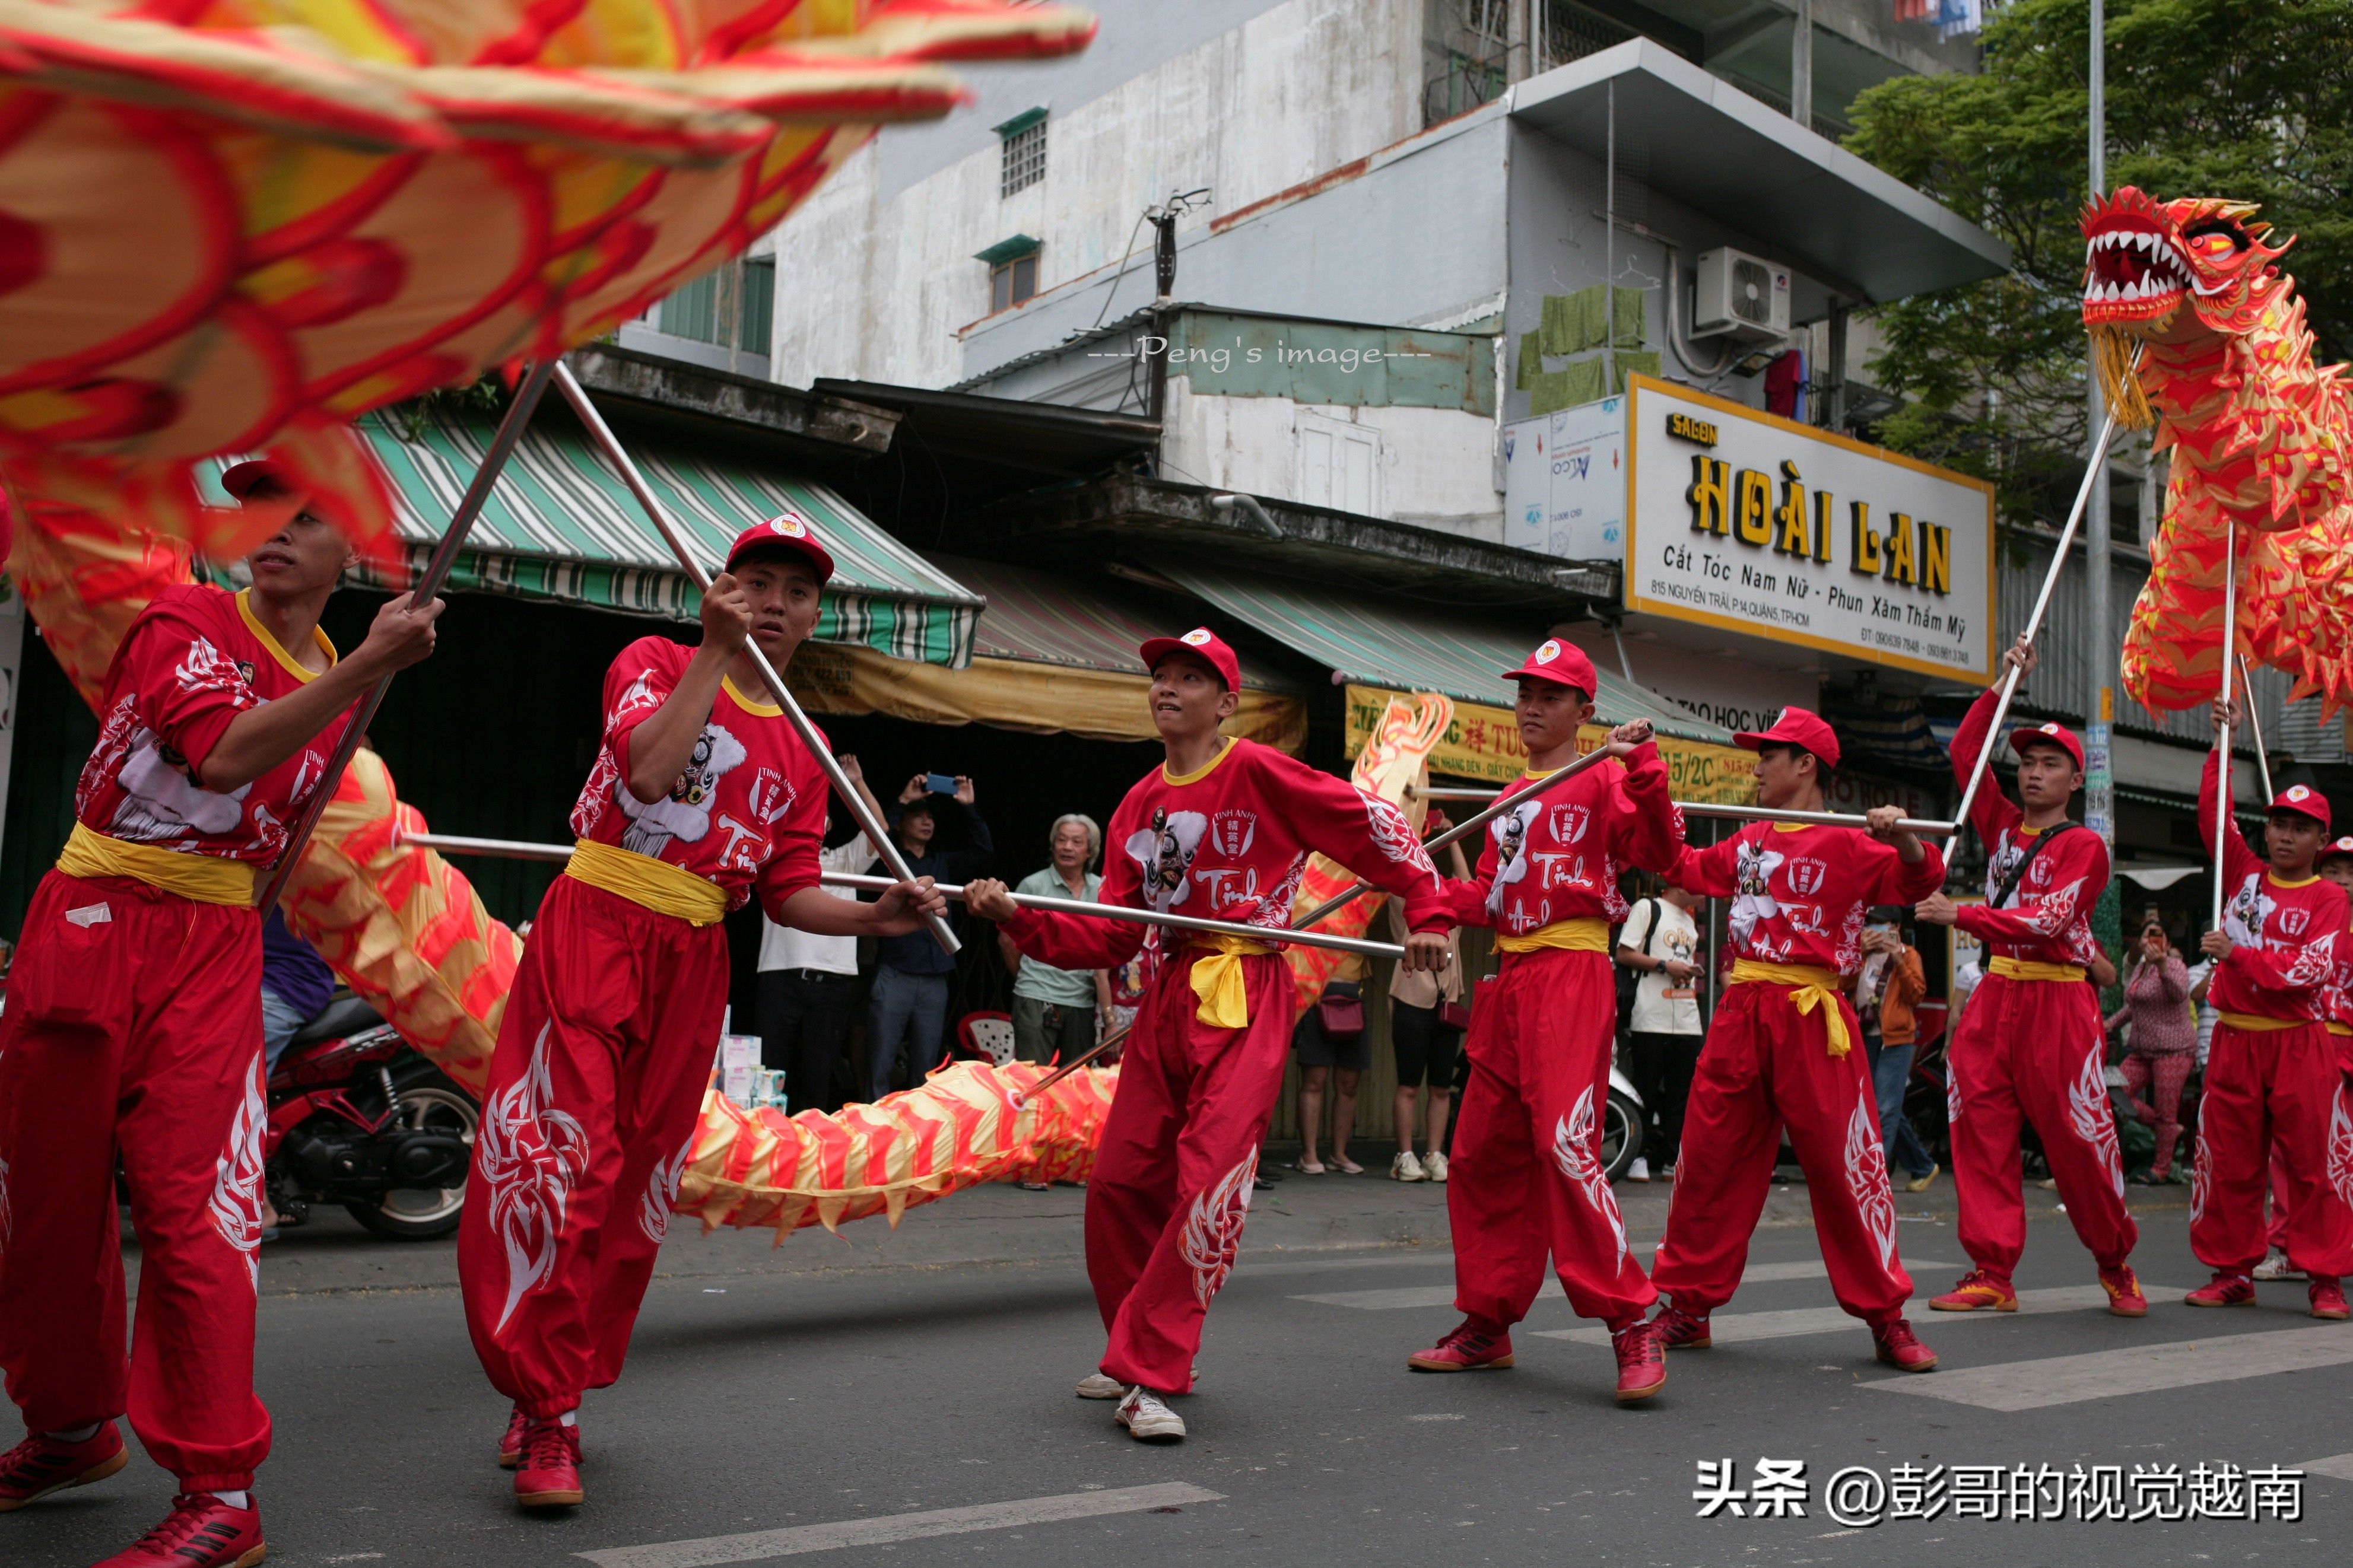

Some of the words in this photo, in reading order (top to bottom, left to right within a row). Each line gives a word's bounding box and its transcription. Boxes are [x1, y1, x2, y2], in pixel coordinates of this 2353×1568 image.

[1667, 412, 1718, 447] SALON
[1687, 454, 1833, 564] HOÀI
[1850, 500, 1951, 594] LAN
[1652, 579, 1666, 594] 815
[1663, 544, 1691, 571] Cắt
[1703, 554, 1730, 580] Tóc
[1741, 564, 1776, 592] Nam
[1786, 575, 1809, 599] Nữ
[1828, 585, 1863, 613] Phun
[1872, 595, 1901, 622] Xăm
[1907, 604, 1942, 631] Thẩm
[1946, 614, 1966, 643] Mỹ
[1465, 718, 1486, 753] 祥
[309, 750, 324, 768] TINH
[762, 768, 781, 783] TINH
[781, 778, 795, 797] ANH
[1215, 809, 1233, 820] TINH
[1234, 809, 1254, 820] ANH
[1554, 803, 1570, 812] TINH
[1572, 804, 1588, 814] ANH
[1227, 820, 1239, 855] 精英堂
[1561, 813, 1574, 841] 精英堂
[1532, 851, 1593, 890] Tinh
[1792, 857, 1808, 865] TINH
[1809, 858, 1825, 867] ANH
[1195, 867, 1265, 910] Tinh
[1799, 866, 1811, 893] 精英堂
